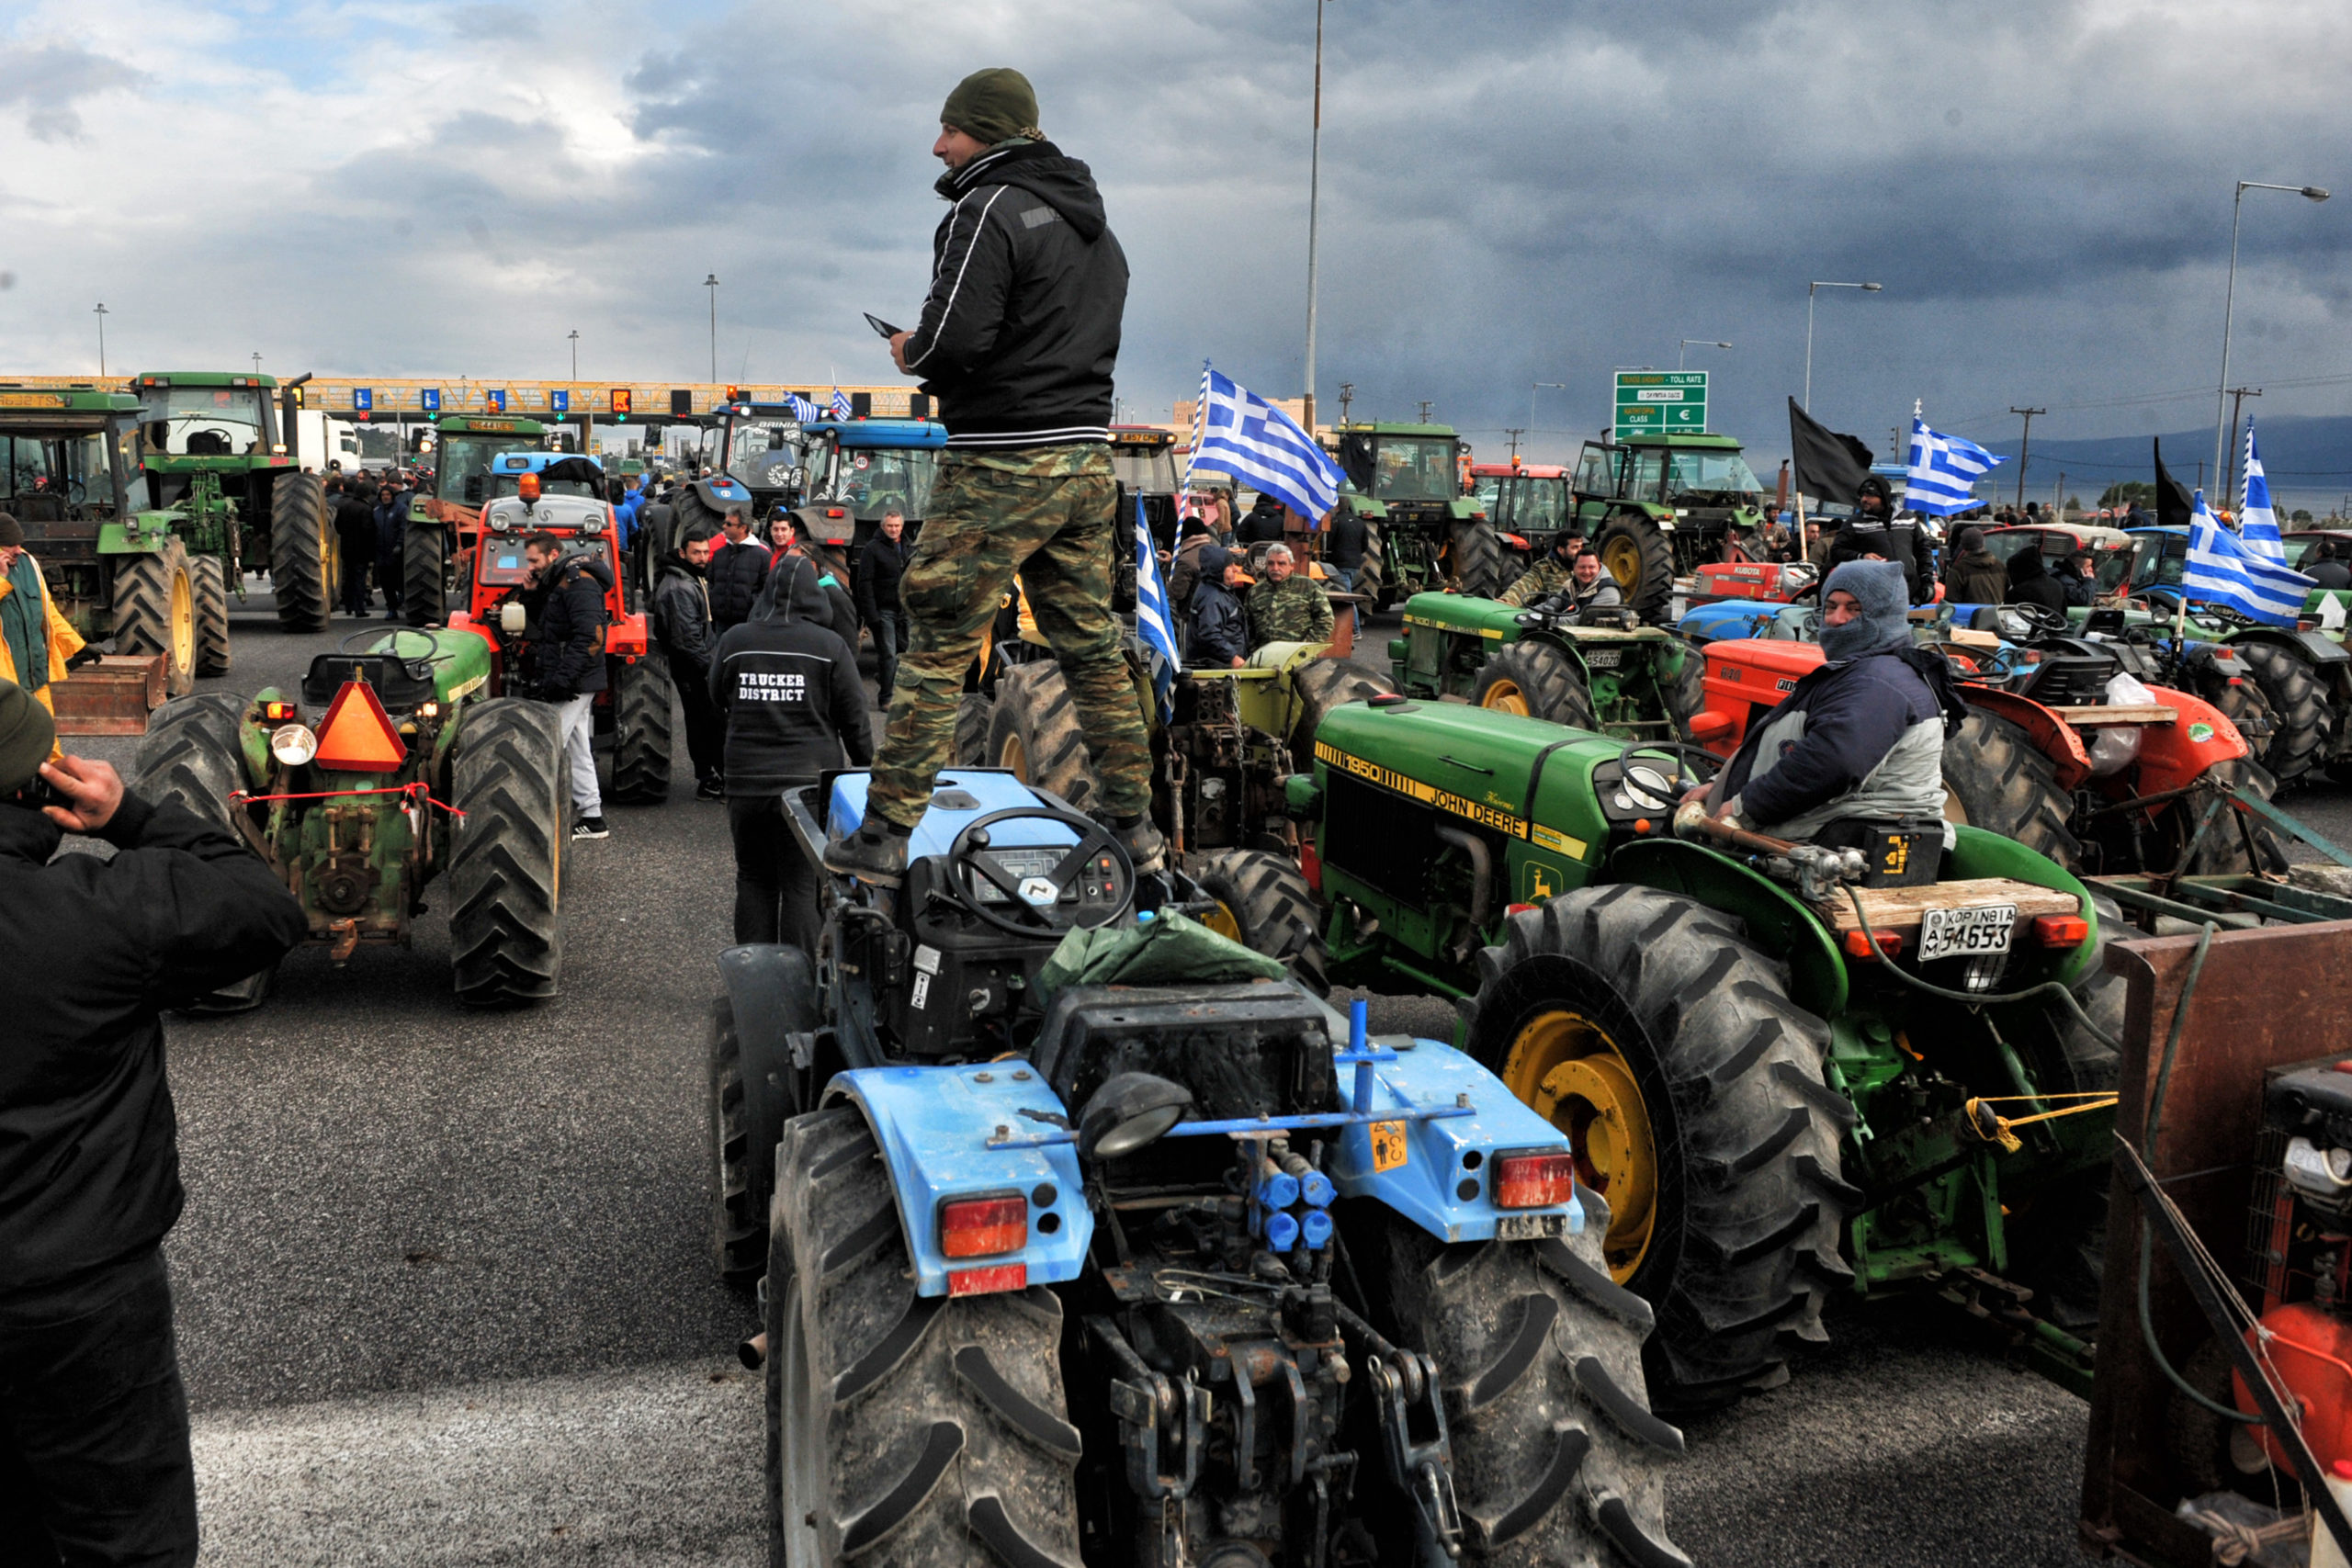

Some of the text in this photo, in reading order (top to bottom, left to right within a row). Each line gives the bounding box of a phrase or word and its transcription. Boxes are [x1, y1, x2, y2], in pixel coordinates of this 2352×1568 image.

[1735, 566, 1760, 575] KUBOTA
[739, 672, 805, 687] TRUCKER
[1720, 666, 1742, 682] 640
[739, 687, 805, 701] DISTRICT
[1345, 754, 1381, 782] 1950
[1430, 789, 1468, 816] JOHN
[1474, 804, 1522, 837] DEERE
[1940, 924, 2010, 952] 54653
